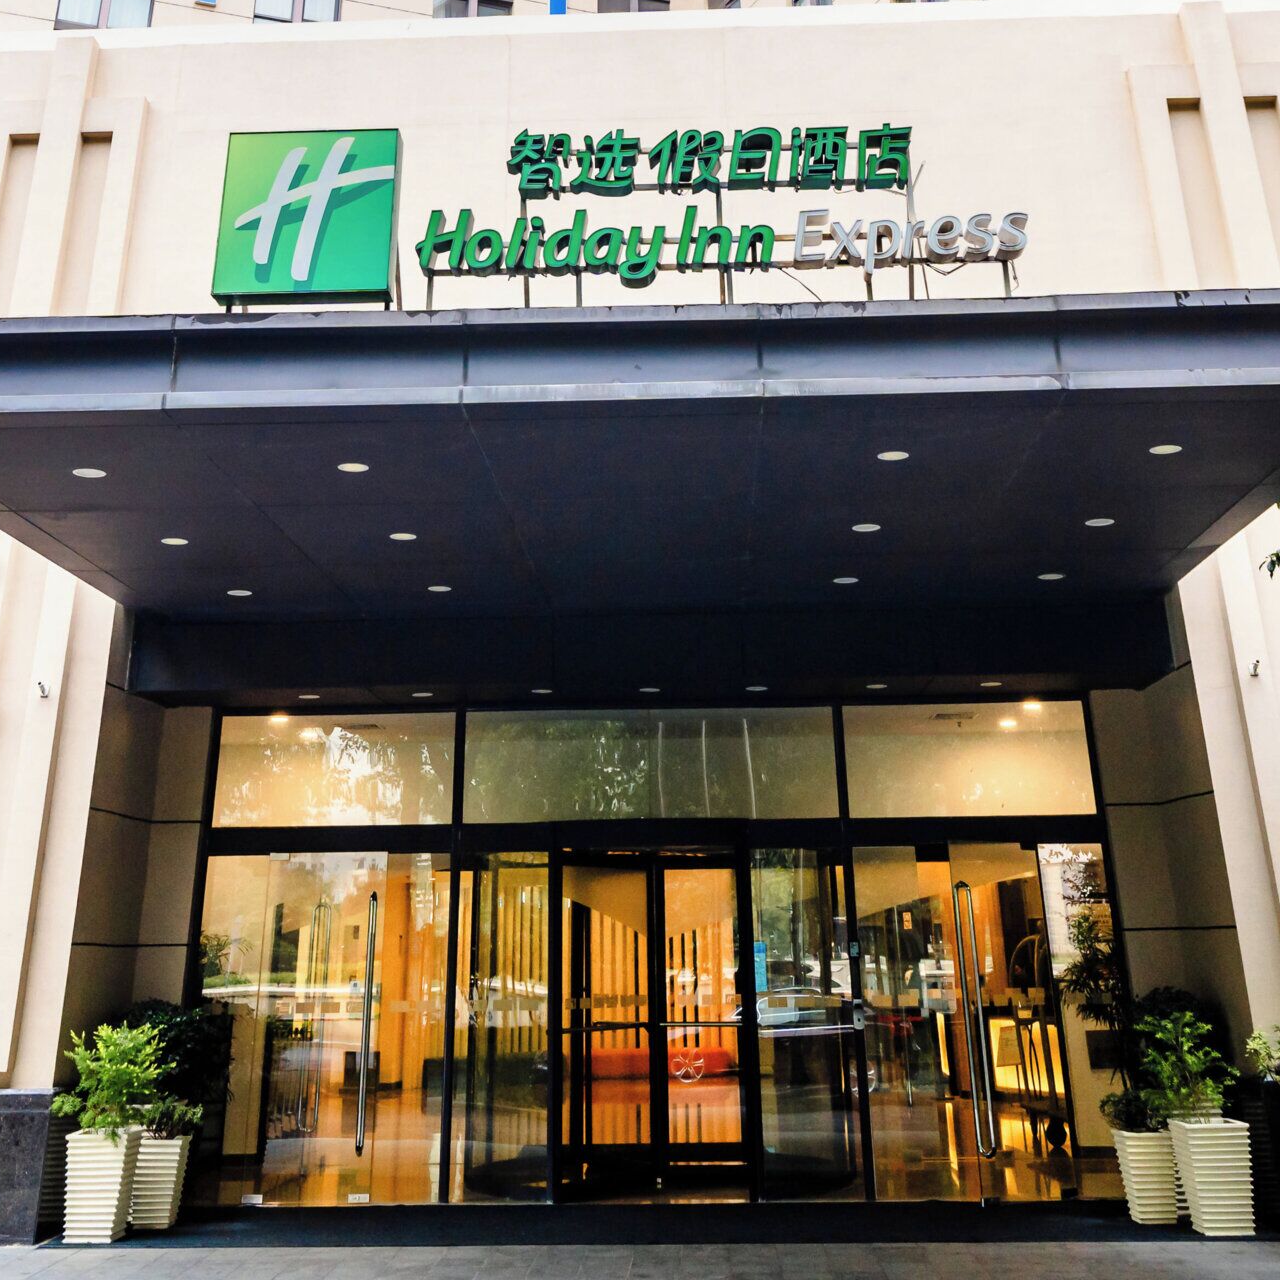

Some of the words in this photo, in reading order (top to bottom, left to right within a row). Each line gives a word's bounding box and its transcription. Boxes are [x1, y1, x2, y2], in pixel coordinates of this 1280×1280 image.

[508, 123, 912, 196] 智选假日酒店
[415, 209, 666, 287] Holiday
[676, 205, 775, 273] Inn
[794, 209, 1028, 275] Express
